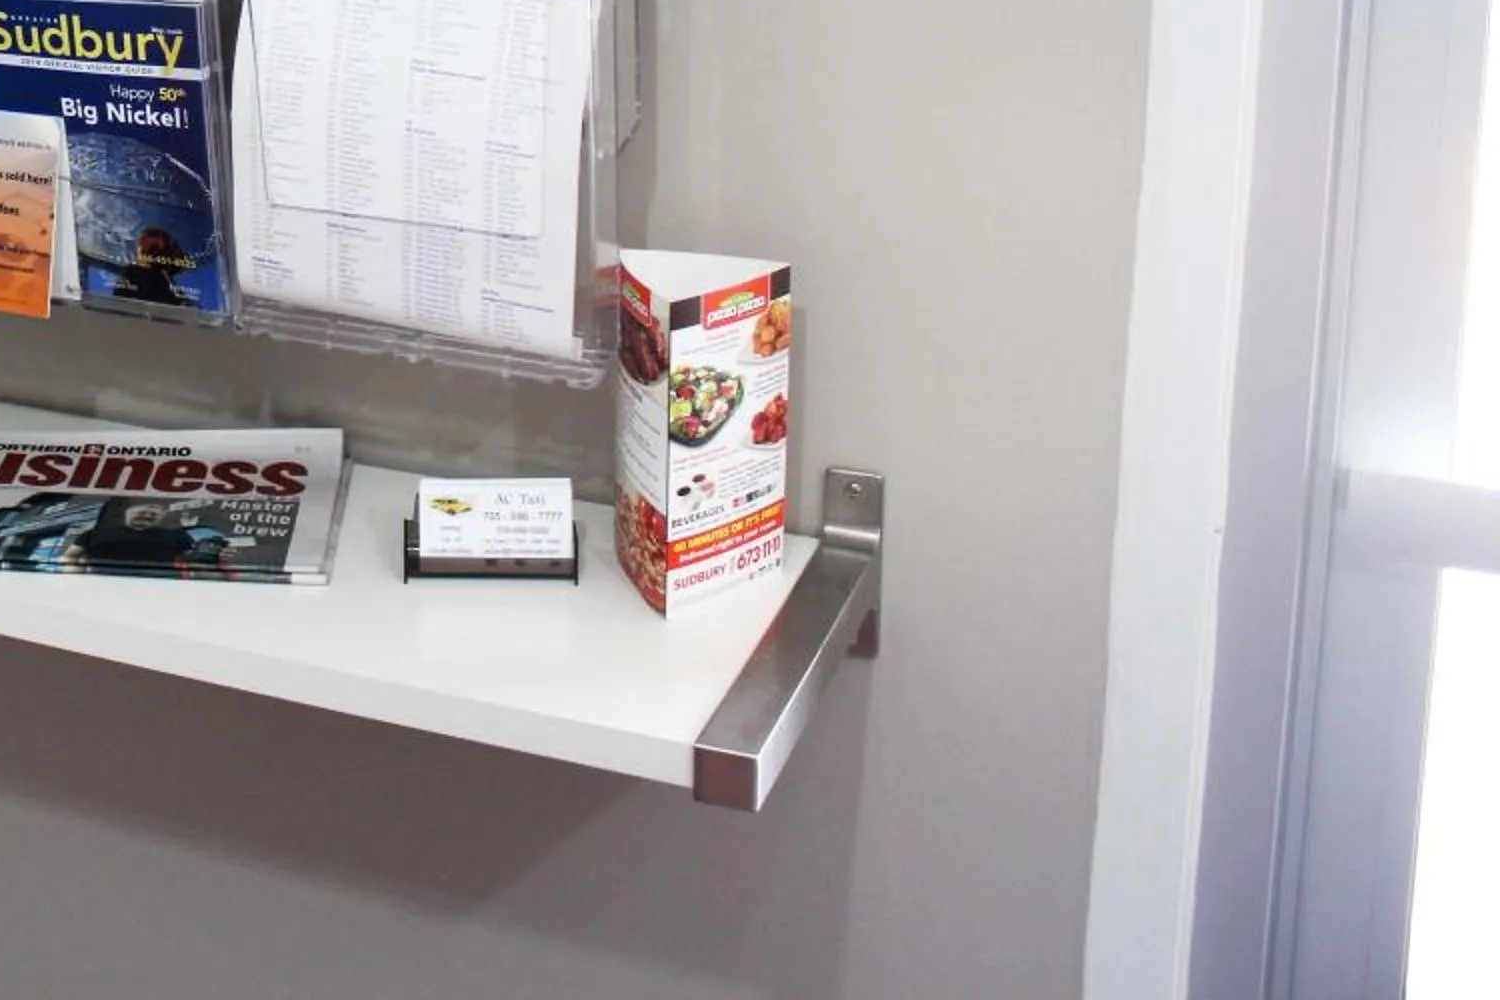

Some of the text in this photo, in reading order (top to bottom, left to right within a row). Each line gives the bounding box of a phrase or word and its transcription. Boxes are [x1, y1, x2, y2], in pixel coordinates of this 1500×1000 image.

[109, 83, 156, 103] Happy
[60, 97, 190, 130] Big Nickel!
[5, 169, 26, 184] sold
[106, 445, 192, 457] ONTARIO
[220, 500, 296, 510] Master
[229, 512, 292, 526] of the
[233, 524, 289, 537] brew
[673, 563, 727, 590] SUDBURY
